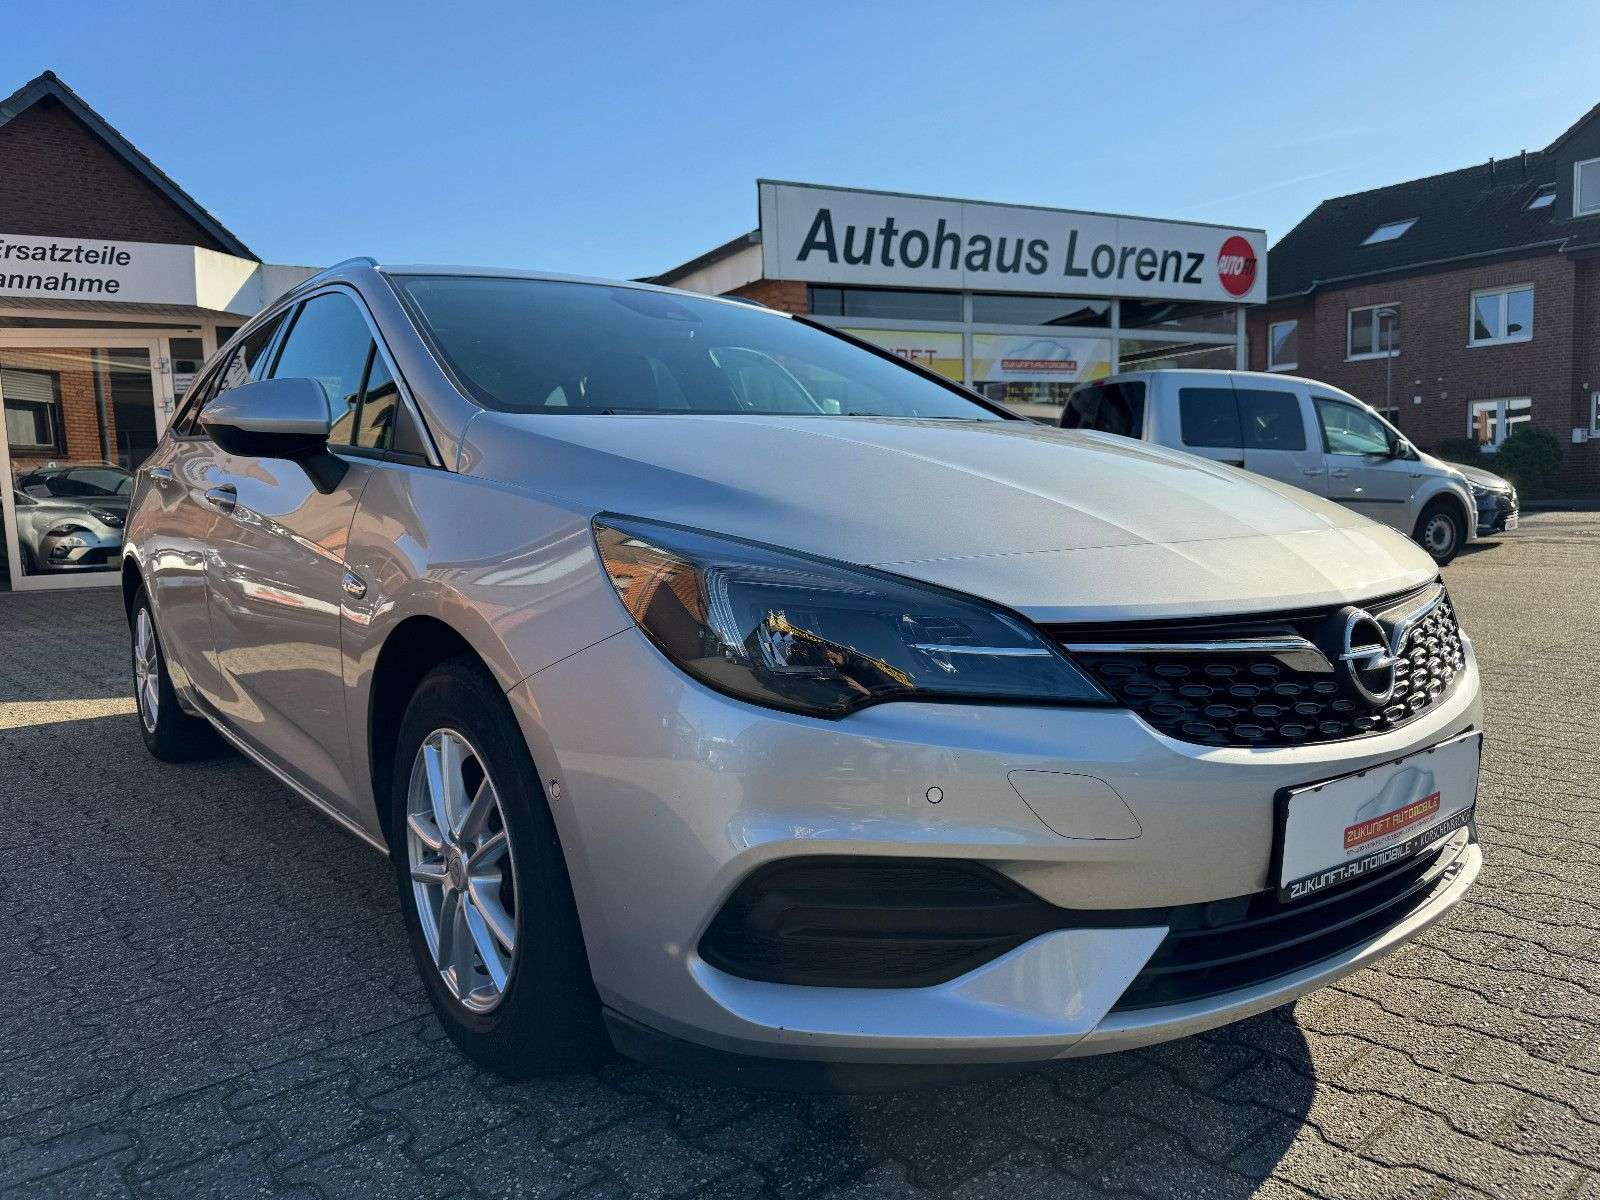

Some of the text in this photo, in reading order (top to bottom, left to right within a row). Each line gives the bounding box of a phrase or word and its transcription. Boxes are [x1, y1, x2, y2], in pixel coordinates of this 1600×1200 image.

[0, 240, 131, 265] rsatzteile
[797, 208, 1204, 284] Autohaus Lorenz
[1347, 817, 1391, 842] ZUKUNFT
[1392, 797, 1438, 826] AUTOMOBILE
